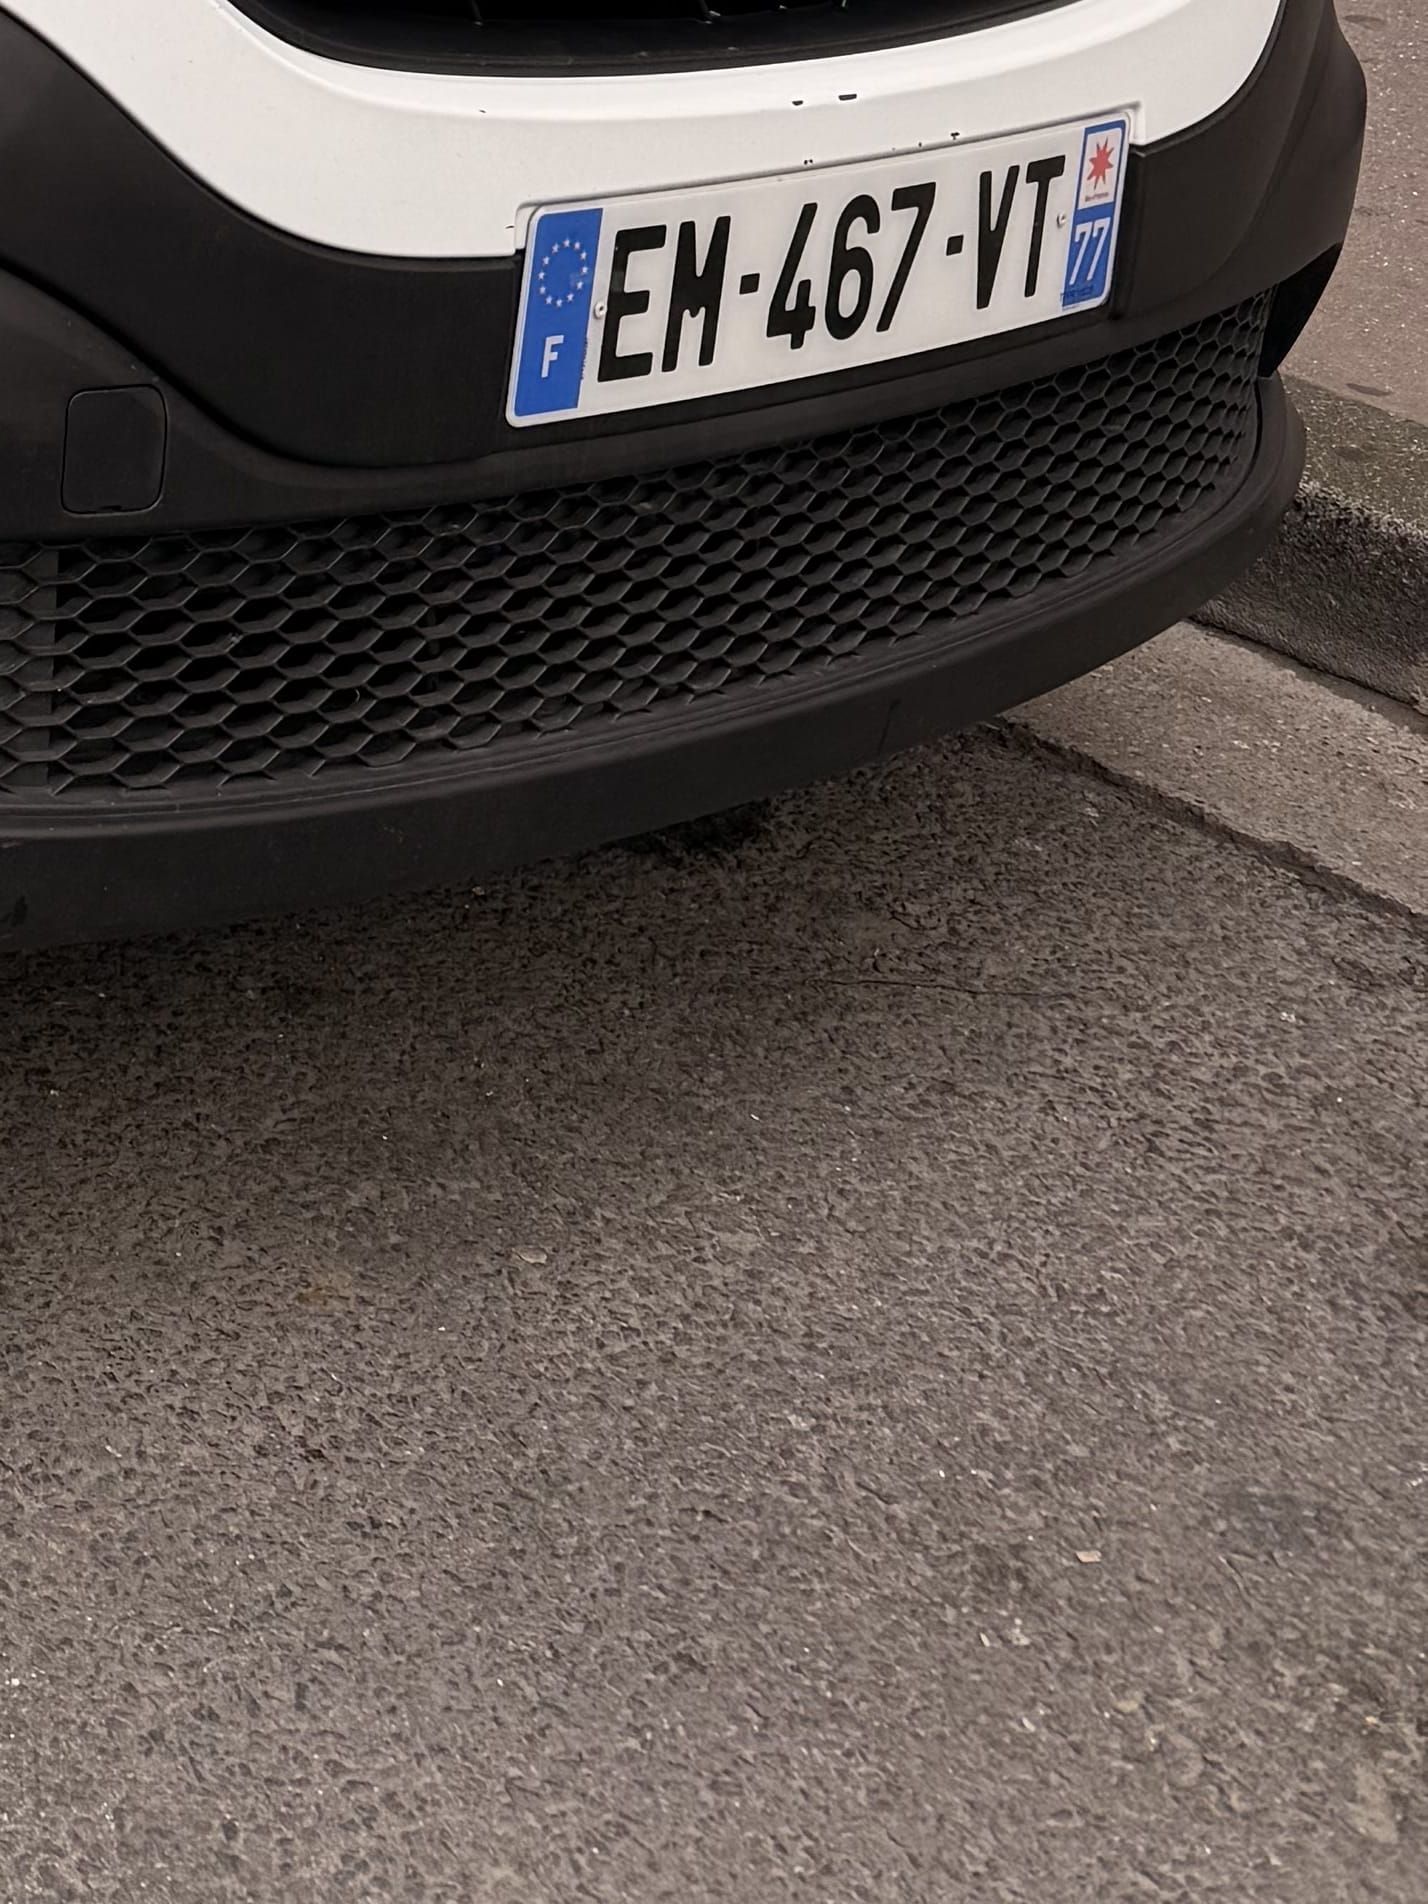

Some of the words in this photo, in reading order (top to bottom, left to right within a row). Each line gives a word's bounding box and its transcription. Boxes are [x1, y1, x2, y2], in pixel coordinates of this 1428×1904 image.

[597, 154, 1066, 382] EM-467-VT
[1069, 216, 1112, 286] 77
[540, 334, 565, 379] F
